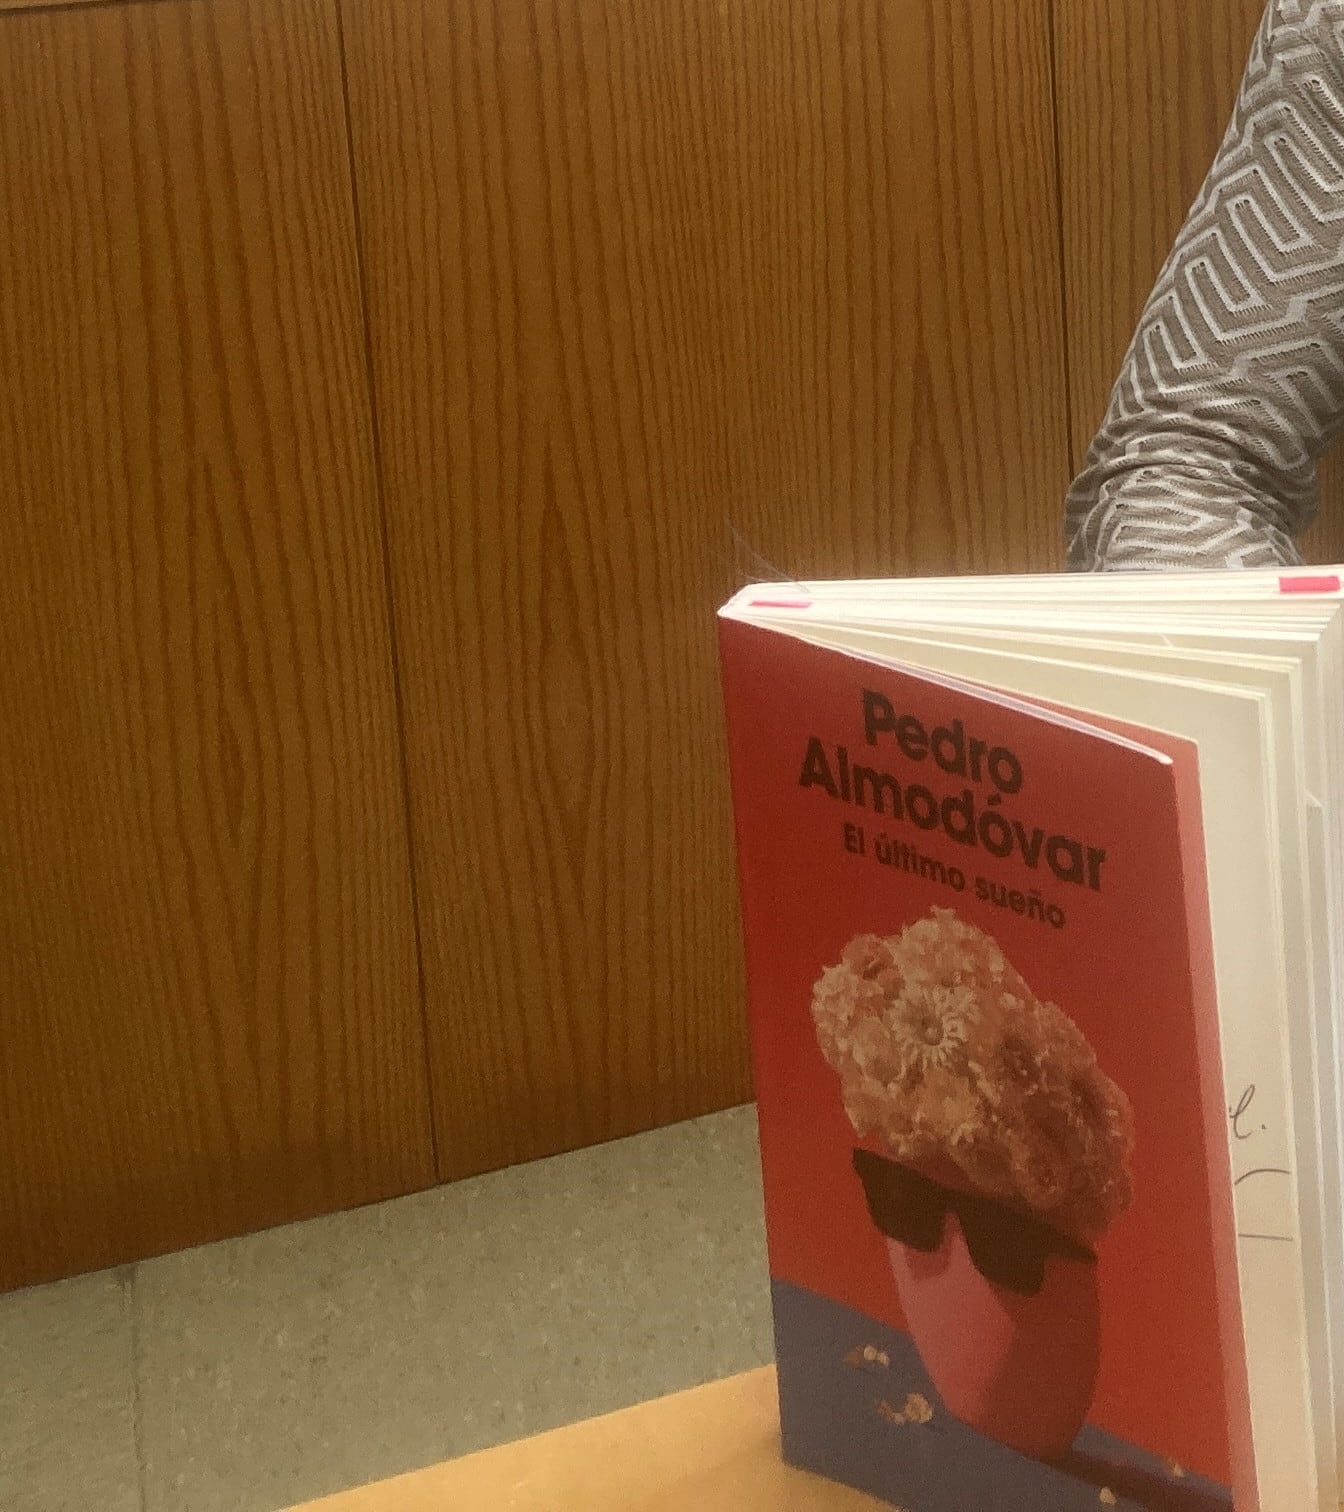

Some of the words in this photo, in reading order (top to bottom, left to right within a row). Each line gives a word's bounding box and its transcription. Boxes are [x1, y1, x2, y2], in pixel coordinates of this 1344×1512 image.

[862, 687, 1023, 794] Pedro
[799, 735, 1107, 892] Almodóvar
[843, 822, 866, 857] El
[875, 832, 966, 892] último
[974, 876, 1066, 930] sueño
